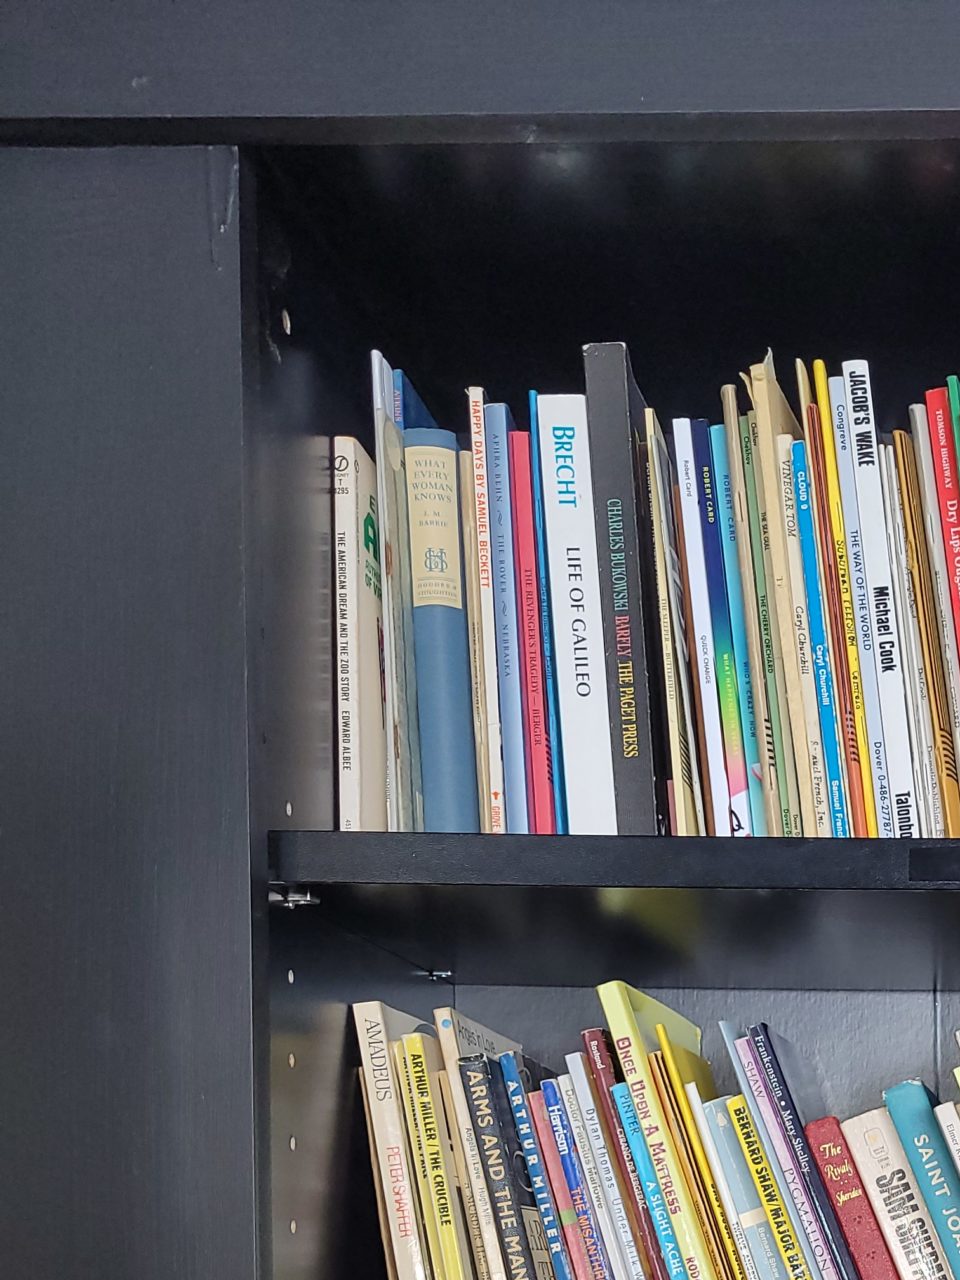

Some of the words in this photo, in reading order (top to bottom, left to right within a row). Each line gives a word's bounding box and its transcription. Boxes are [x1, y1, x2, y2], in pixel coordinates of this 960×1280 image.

[472, 401, 482, 435] HAPPY
[849, 371, 870, 425] JACOB'S
[474, 439, 484, 470] DAYS
[553, 426, 579, 508] BRECHT
[856, 431, 874, 467] WAKE
[476, 474, 485, 488] BY
[477, 492, 487, 535] SAMUEL
[607, 499, 625, 550] CHARLES
[479, 540, 490, 588] BECKETT
[566, 547, 583, 581] LIFE
[610, 552, 629, 611] BUKOWSKI
[569, 587, 585, 613] OF
[874, 587, 893, 636] Michael
[571, 618, 591, 697] GALILEO
[615, 615, 632, 656] BARFLY
[879, 641, 896, 672] Cook
[618, 662, 634, 685] THE
[620, 687, 637, 721] PAGET
[622, 724, 639, 758] PRESS
[364, 1018, 391, 1102] AMADEUS
[465, 1071, 496, 1127] ARMS
[754, 1036, 786, 1097] Frankenstein
[778, 1111, 800, 1136] Mary
[789, 1139, 813, 1172] Shelley
[387, 1147, 402, 1183] PETER
[480, 1133, 508, 1180] AND
[507, 1081, 541, 1166] ARTHUR
[532, 1180, 564, 1253] MILLER
[914, 1134, 953, 1197] SAINT
[393, 1186, 411, 1238] SHAFFER
[492, 1186, 519, 1228] THE
